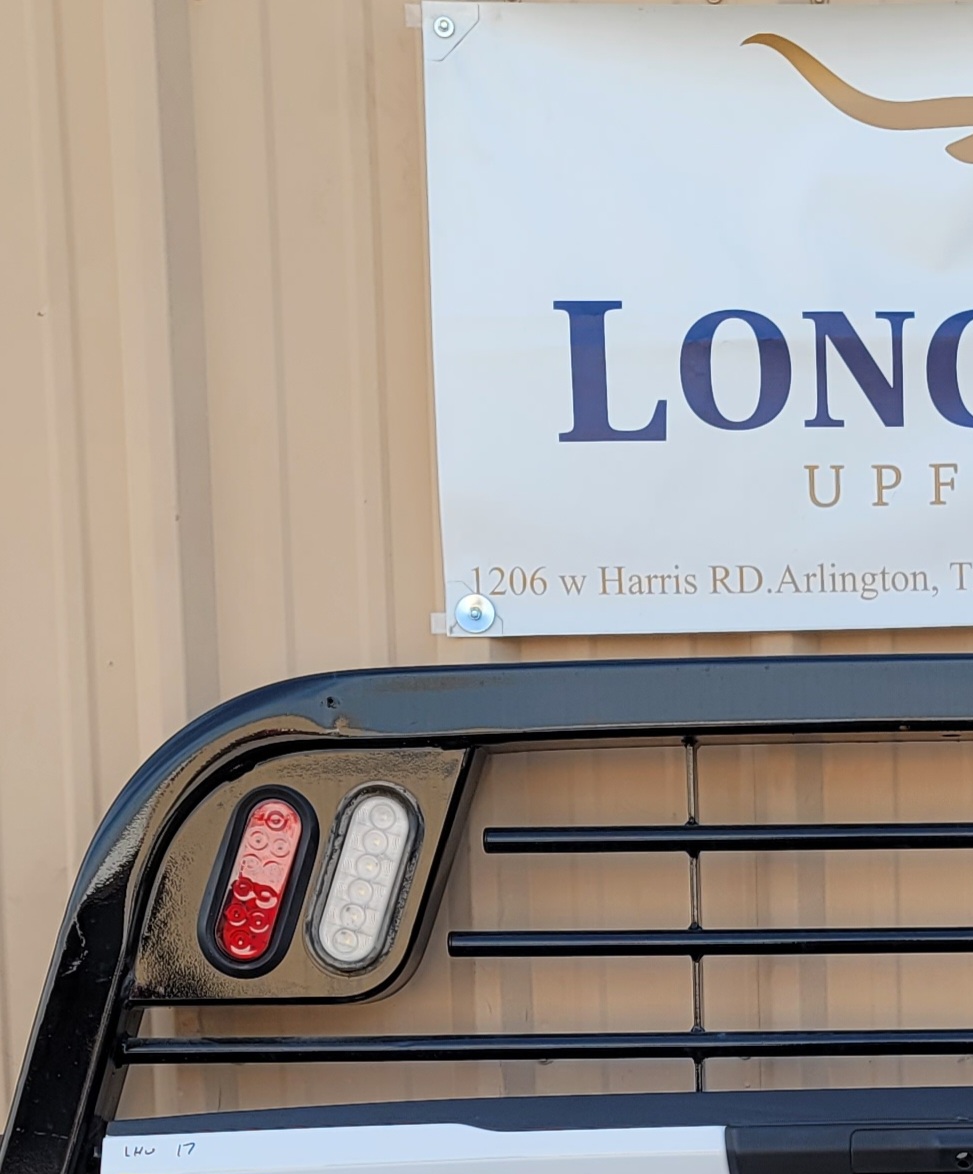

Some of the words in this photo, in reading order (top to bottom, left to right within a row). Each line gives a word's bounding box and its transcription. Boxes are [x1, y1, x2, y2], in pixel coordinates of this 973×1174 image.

[470, 566, 548, 596] 1206
[559, 575, 587, 595] w
[597, 564, 698, 595] Harris
[707, 562, 939, 600] RD.Arlington,
